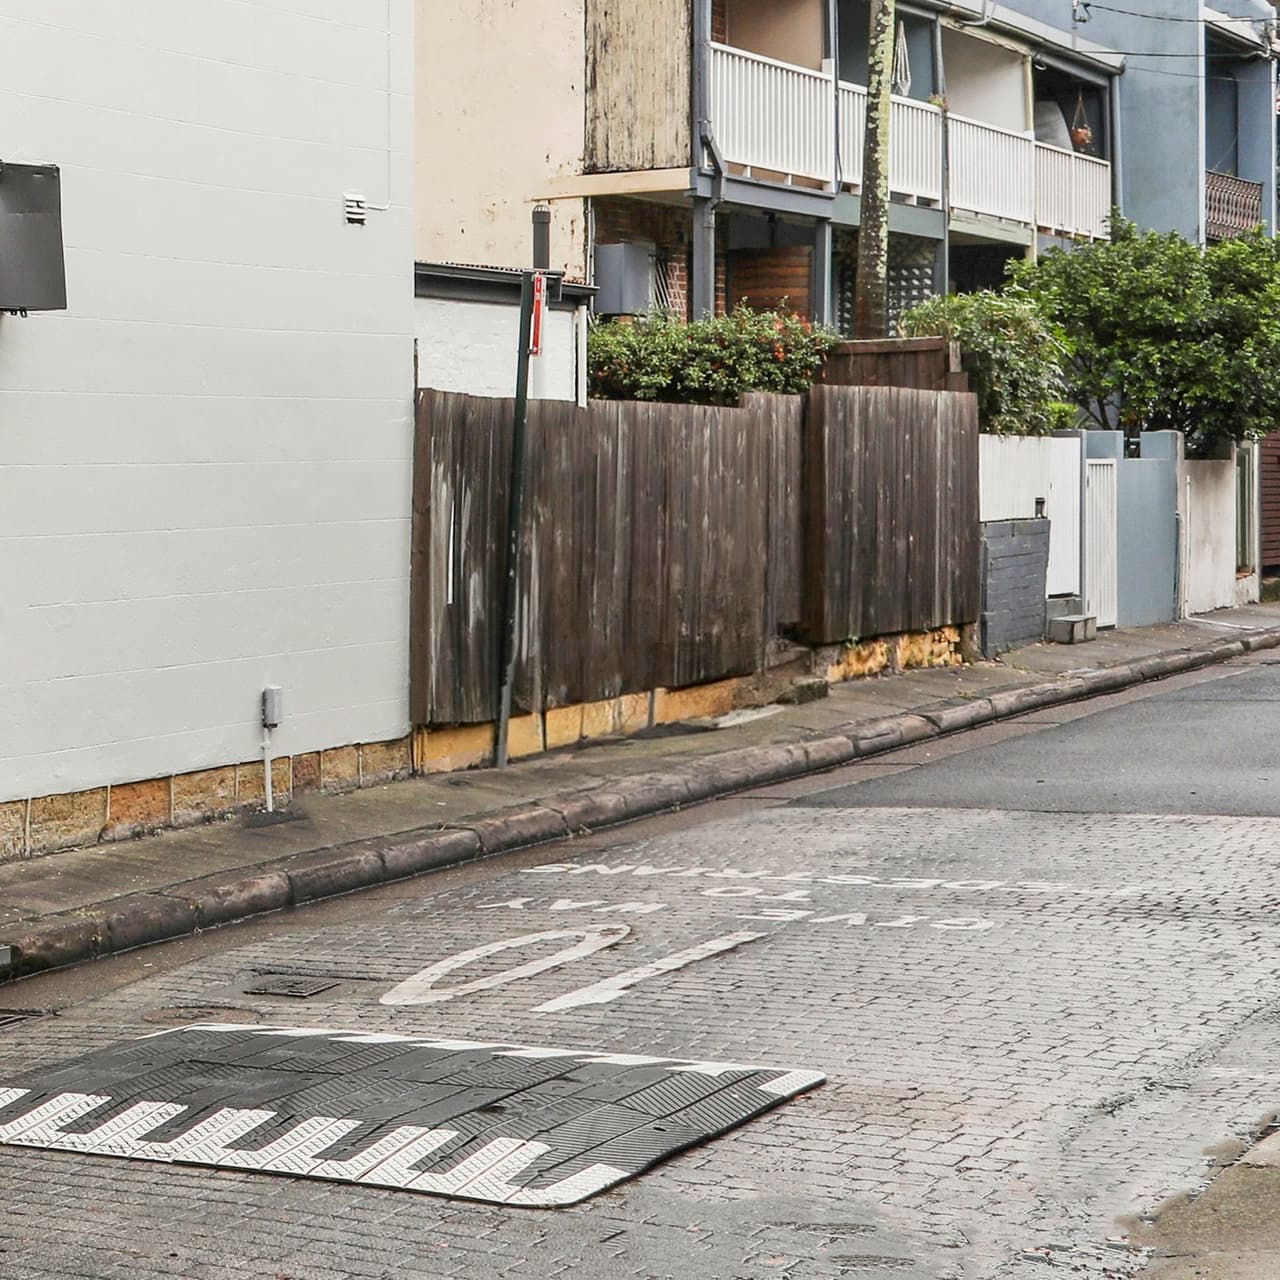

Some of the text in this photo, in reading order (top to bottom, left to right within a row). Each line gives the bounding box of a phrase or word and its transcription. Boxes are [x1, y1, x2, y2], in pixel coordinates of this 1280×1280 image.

[520, 863, 1155, 896] EDESTRIANS
[700, 886, 812, 902] TO
[475, 897, 995, 930] GIVE WAY
